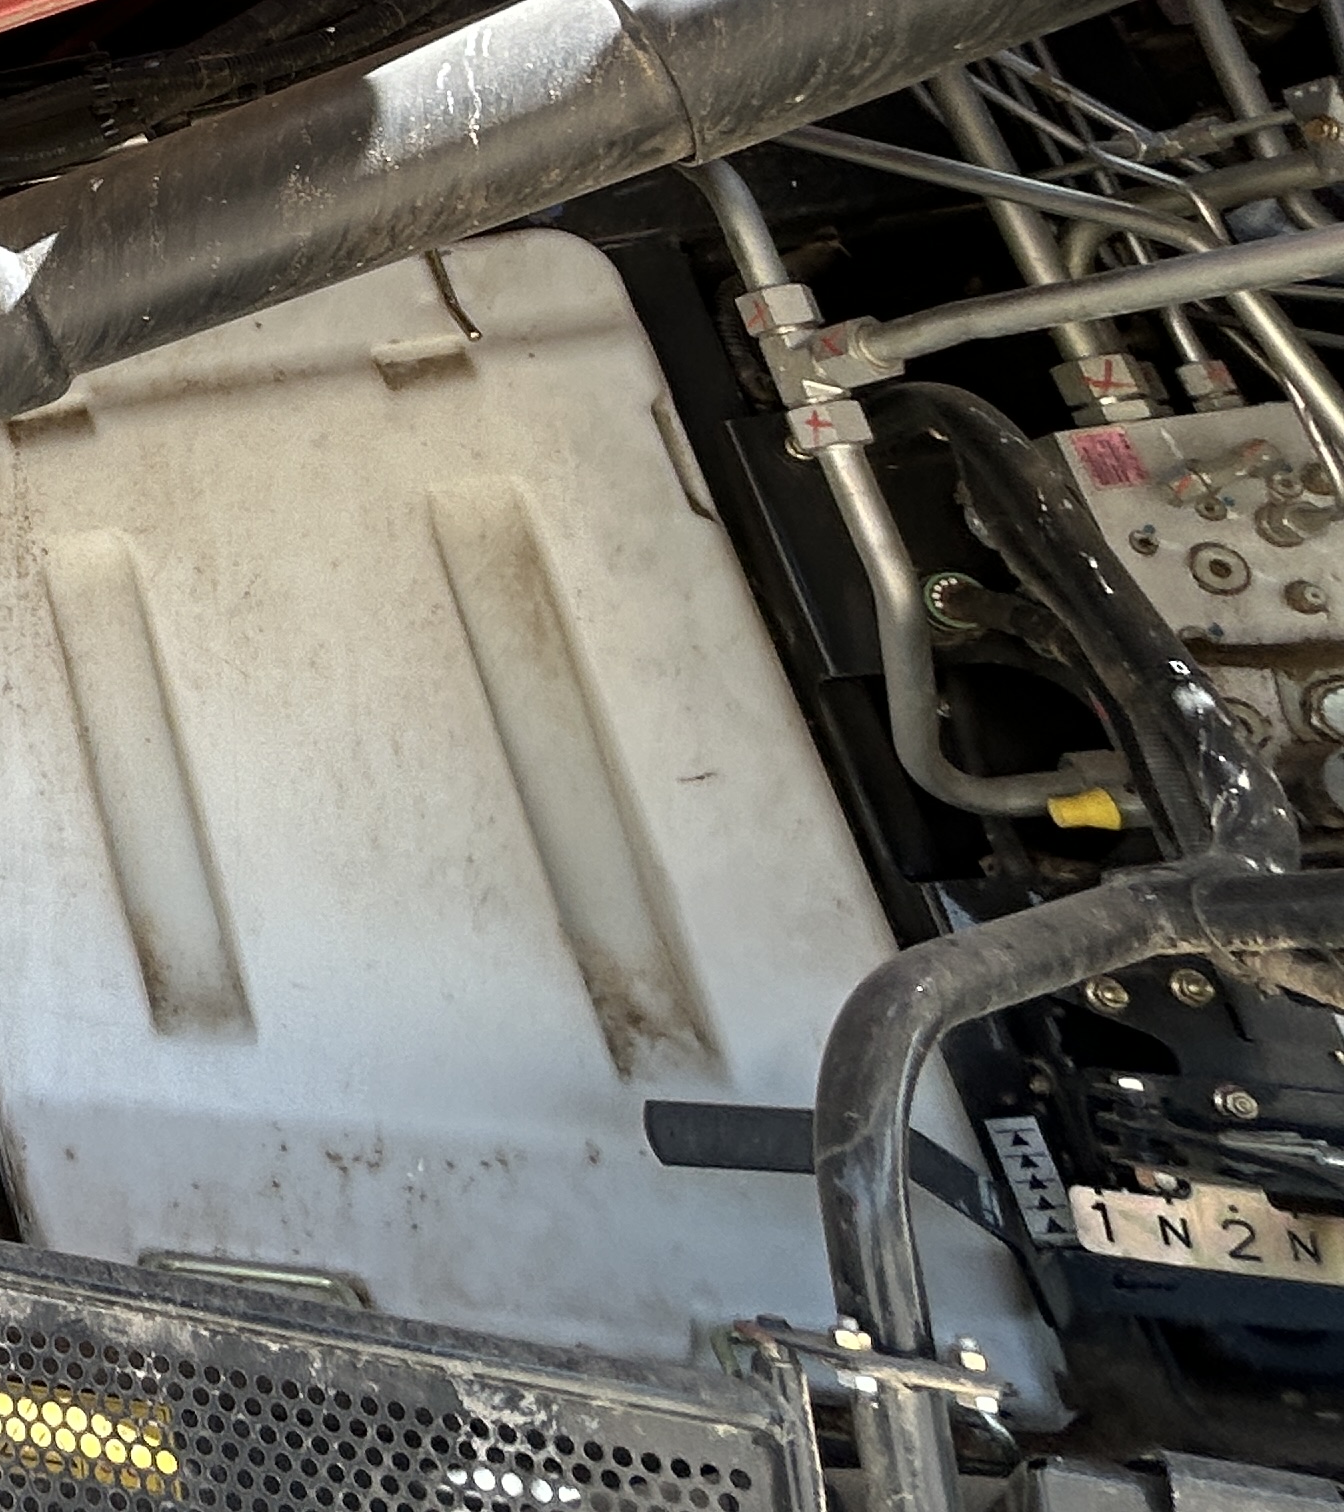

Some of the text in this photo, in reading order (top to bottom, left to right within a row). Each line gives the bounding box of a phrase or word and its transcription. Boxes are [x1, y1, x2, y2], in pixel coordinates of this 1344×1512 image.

[1092, 1202, 1323, 1264] 1 N 2 N
